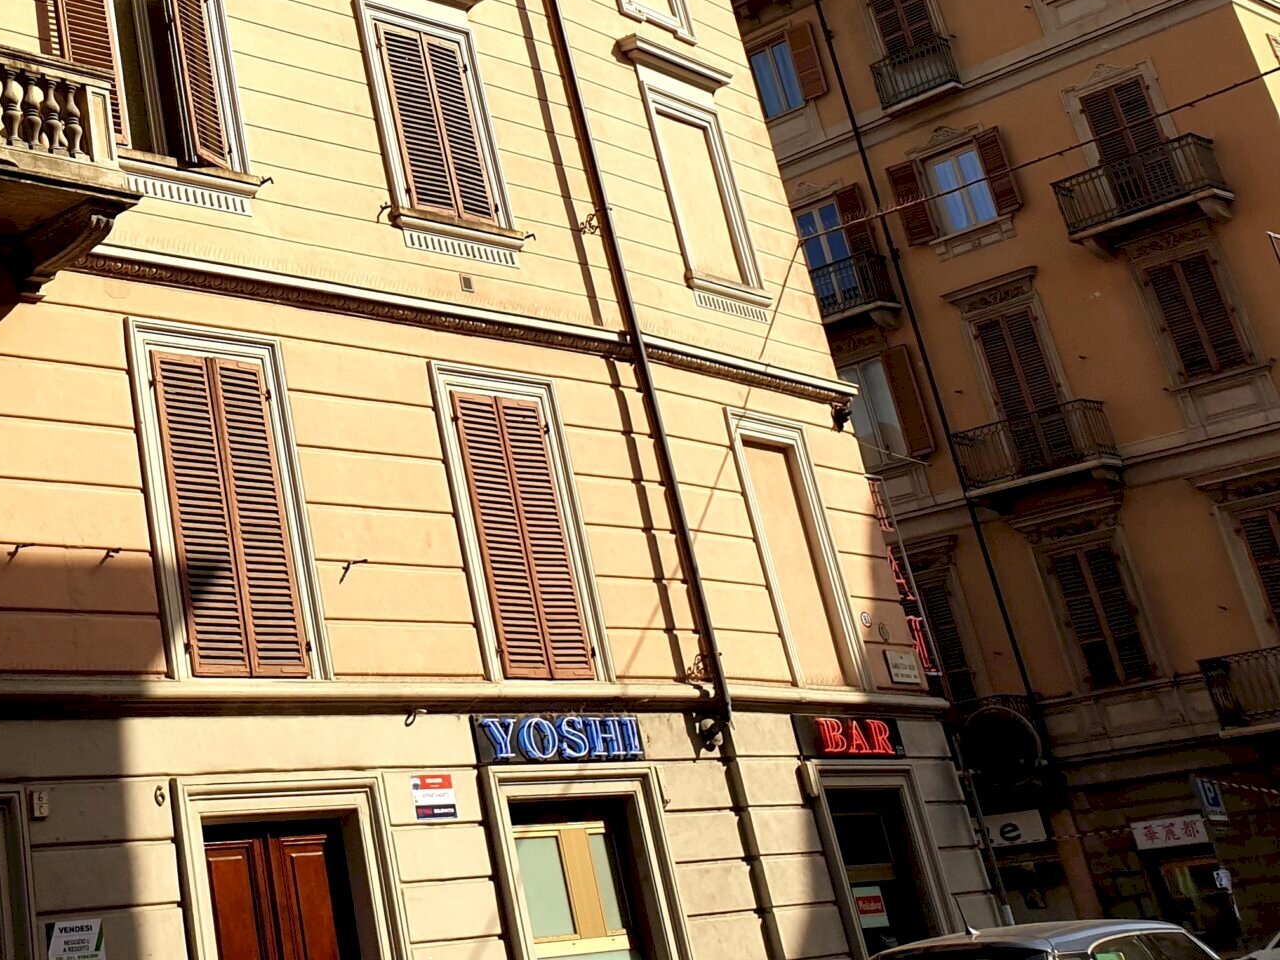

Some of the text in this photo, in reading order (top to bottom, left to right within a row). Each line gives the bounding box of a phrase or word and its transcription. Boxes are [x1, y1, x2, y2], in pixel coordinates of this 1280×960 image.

[481, 716, 644, 759] YOSHI
[815, 717, 896, 754] BAR
[154, 785, 166, 807] 6
[58, 924, 93, 934] VENDESI
